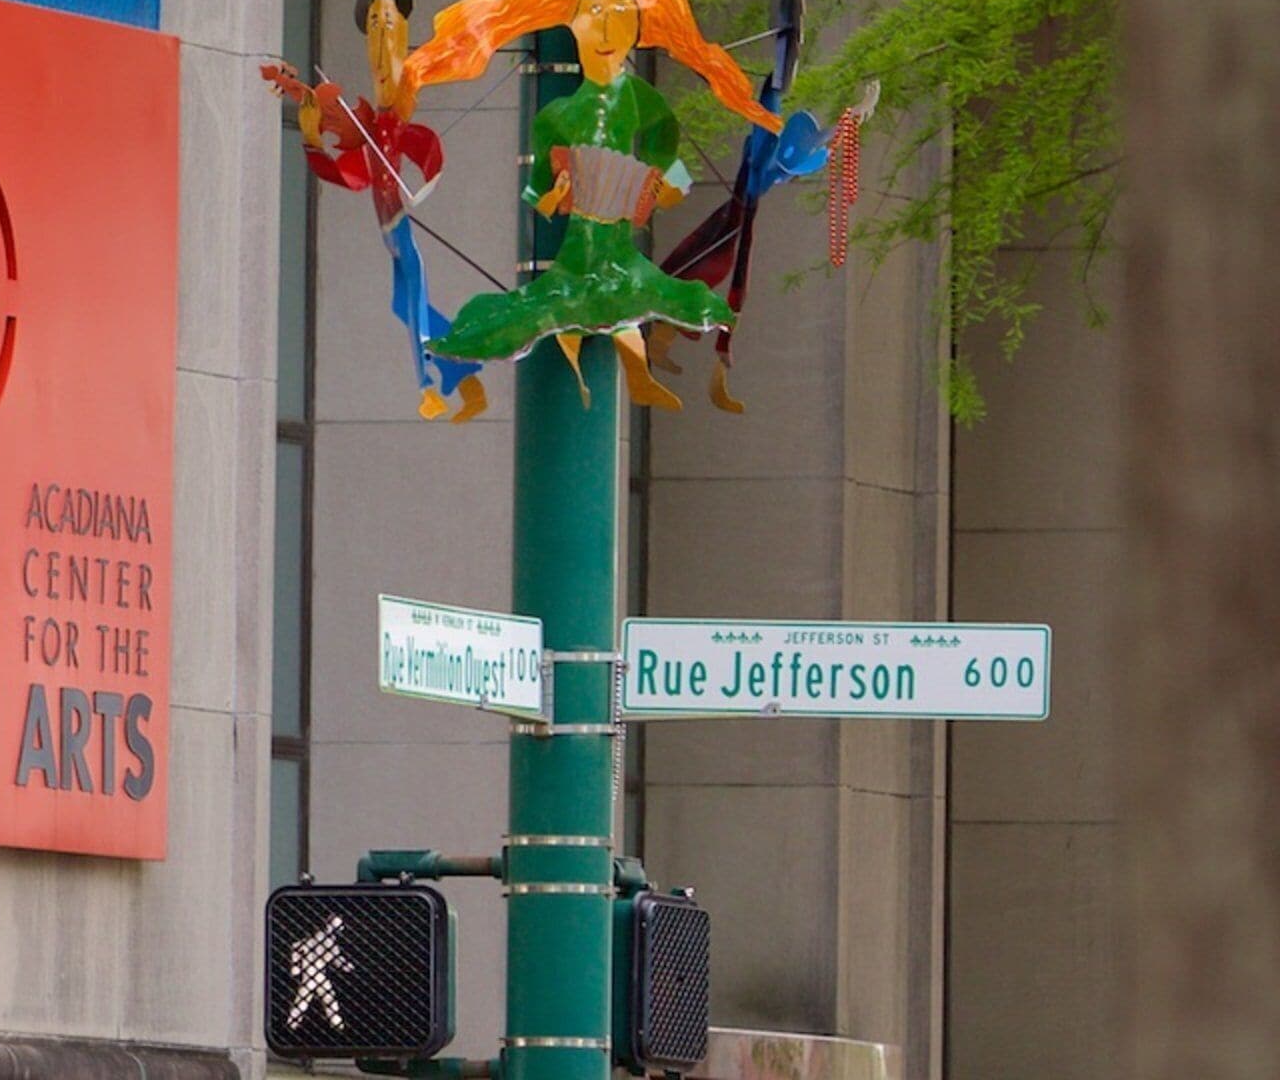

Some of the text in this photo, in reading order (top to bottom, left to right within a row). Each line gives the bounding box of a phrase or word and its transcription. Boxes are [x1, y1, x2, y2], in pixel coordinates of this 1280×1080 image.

[25, 483, 152, 545] ACADIANA
[23, 547, 152, 612] CENTER
[23, 615, 149, 677] FOR THE
[783, 632, 889, 646] JEFFERSON ST
[465, 645, 506, 699] Ouest
[637, 648, 1036, 701] Rue Jefferson 600
[14, 682, 155, 802] ARTS
